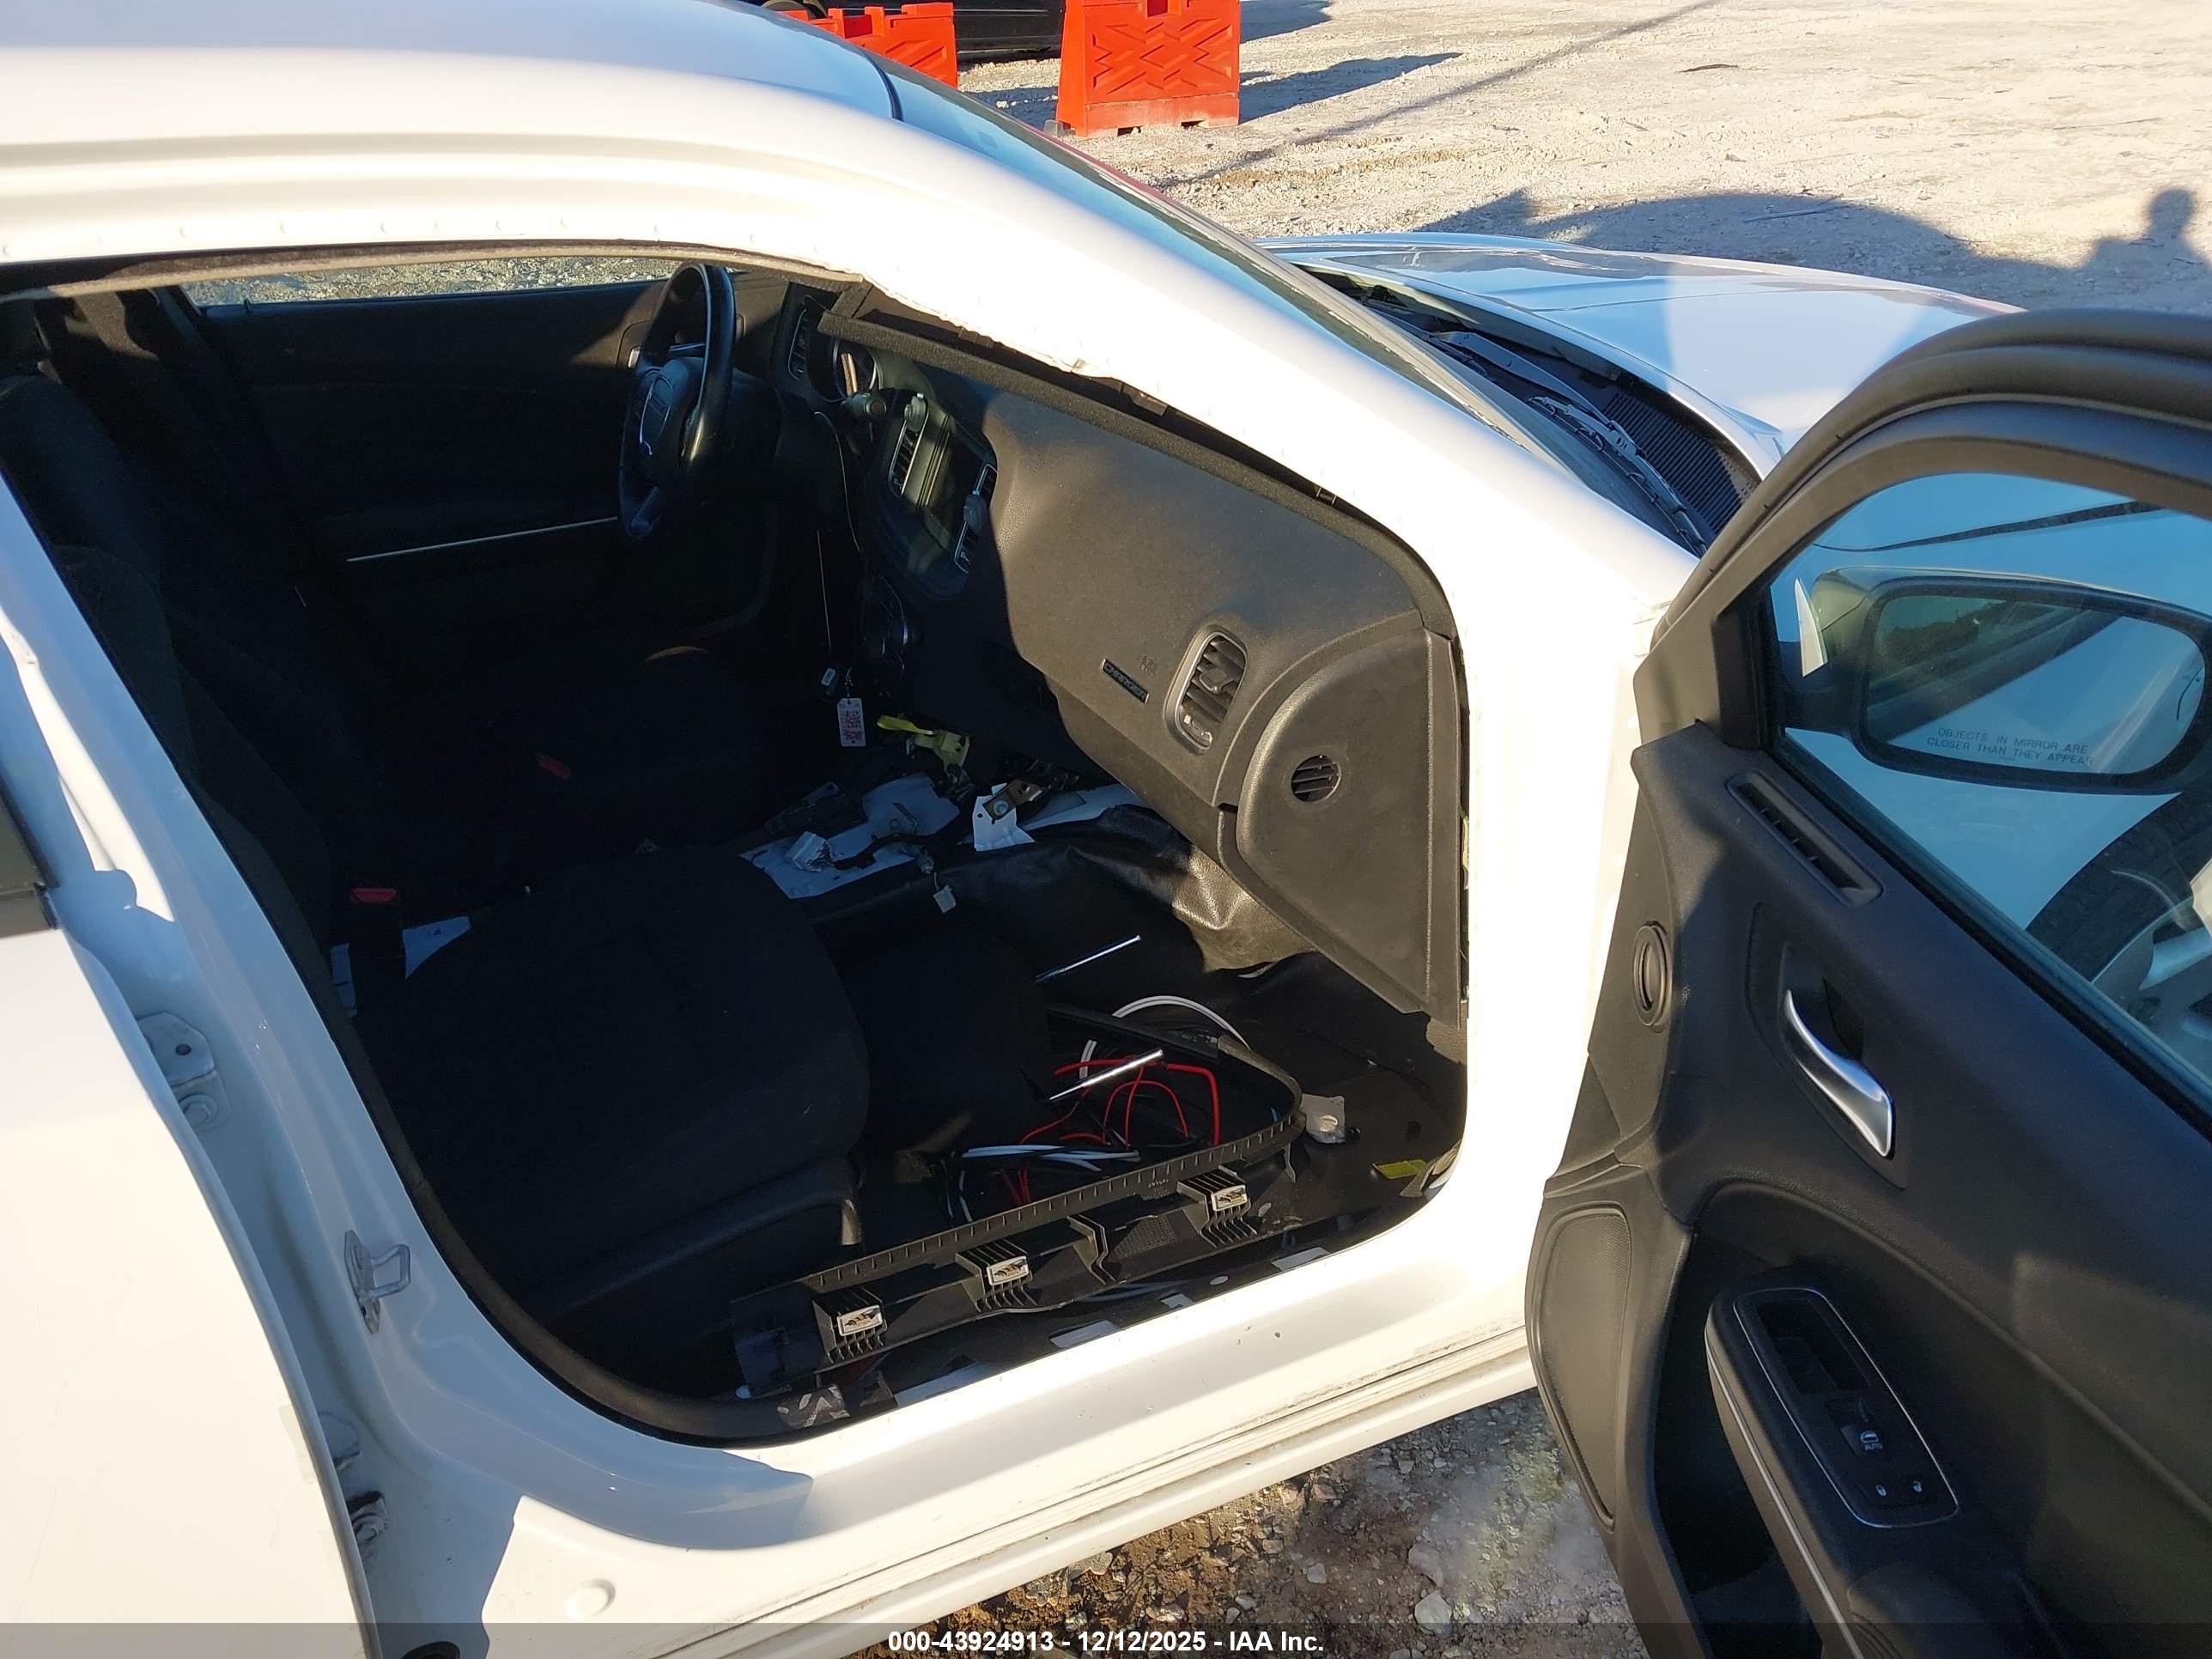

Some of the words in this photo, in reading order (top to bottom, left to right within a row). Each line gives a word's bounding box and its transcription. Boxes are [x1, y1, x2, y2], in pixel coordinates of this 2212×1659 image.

[1927, 737, 1971, 750] CLOSER
[1978, 744, 2007, 756] THAN
[2014, 747, 2041, 760] THEY
[1938, 727, 1988, 743] OBJECTS
[1997, 734, 2008, 744] IN
[2014, 738, 2059, 750] MIRROR
[2064, 743, 2088, 755] ARE
